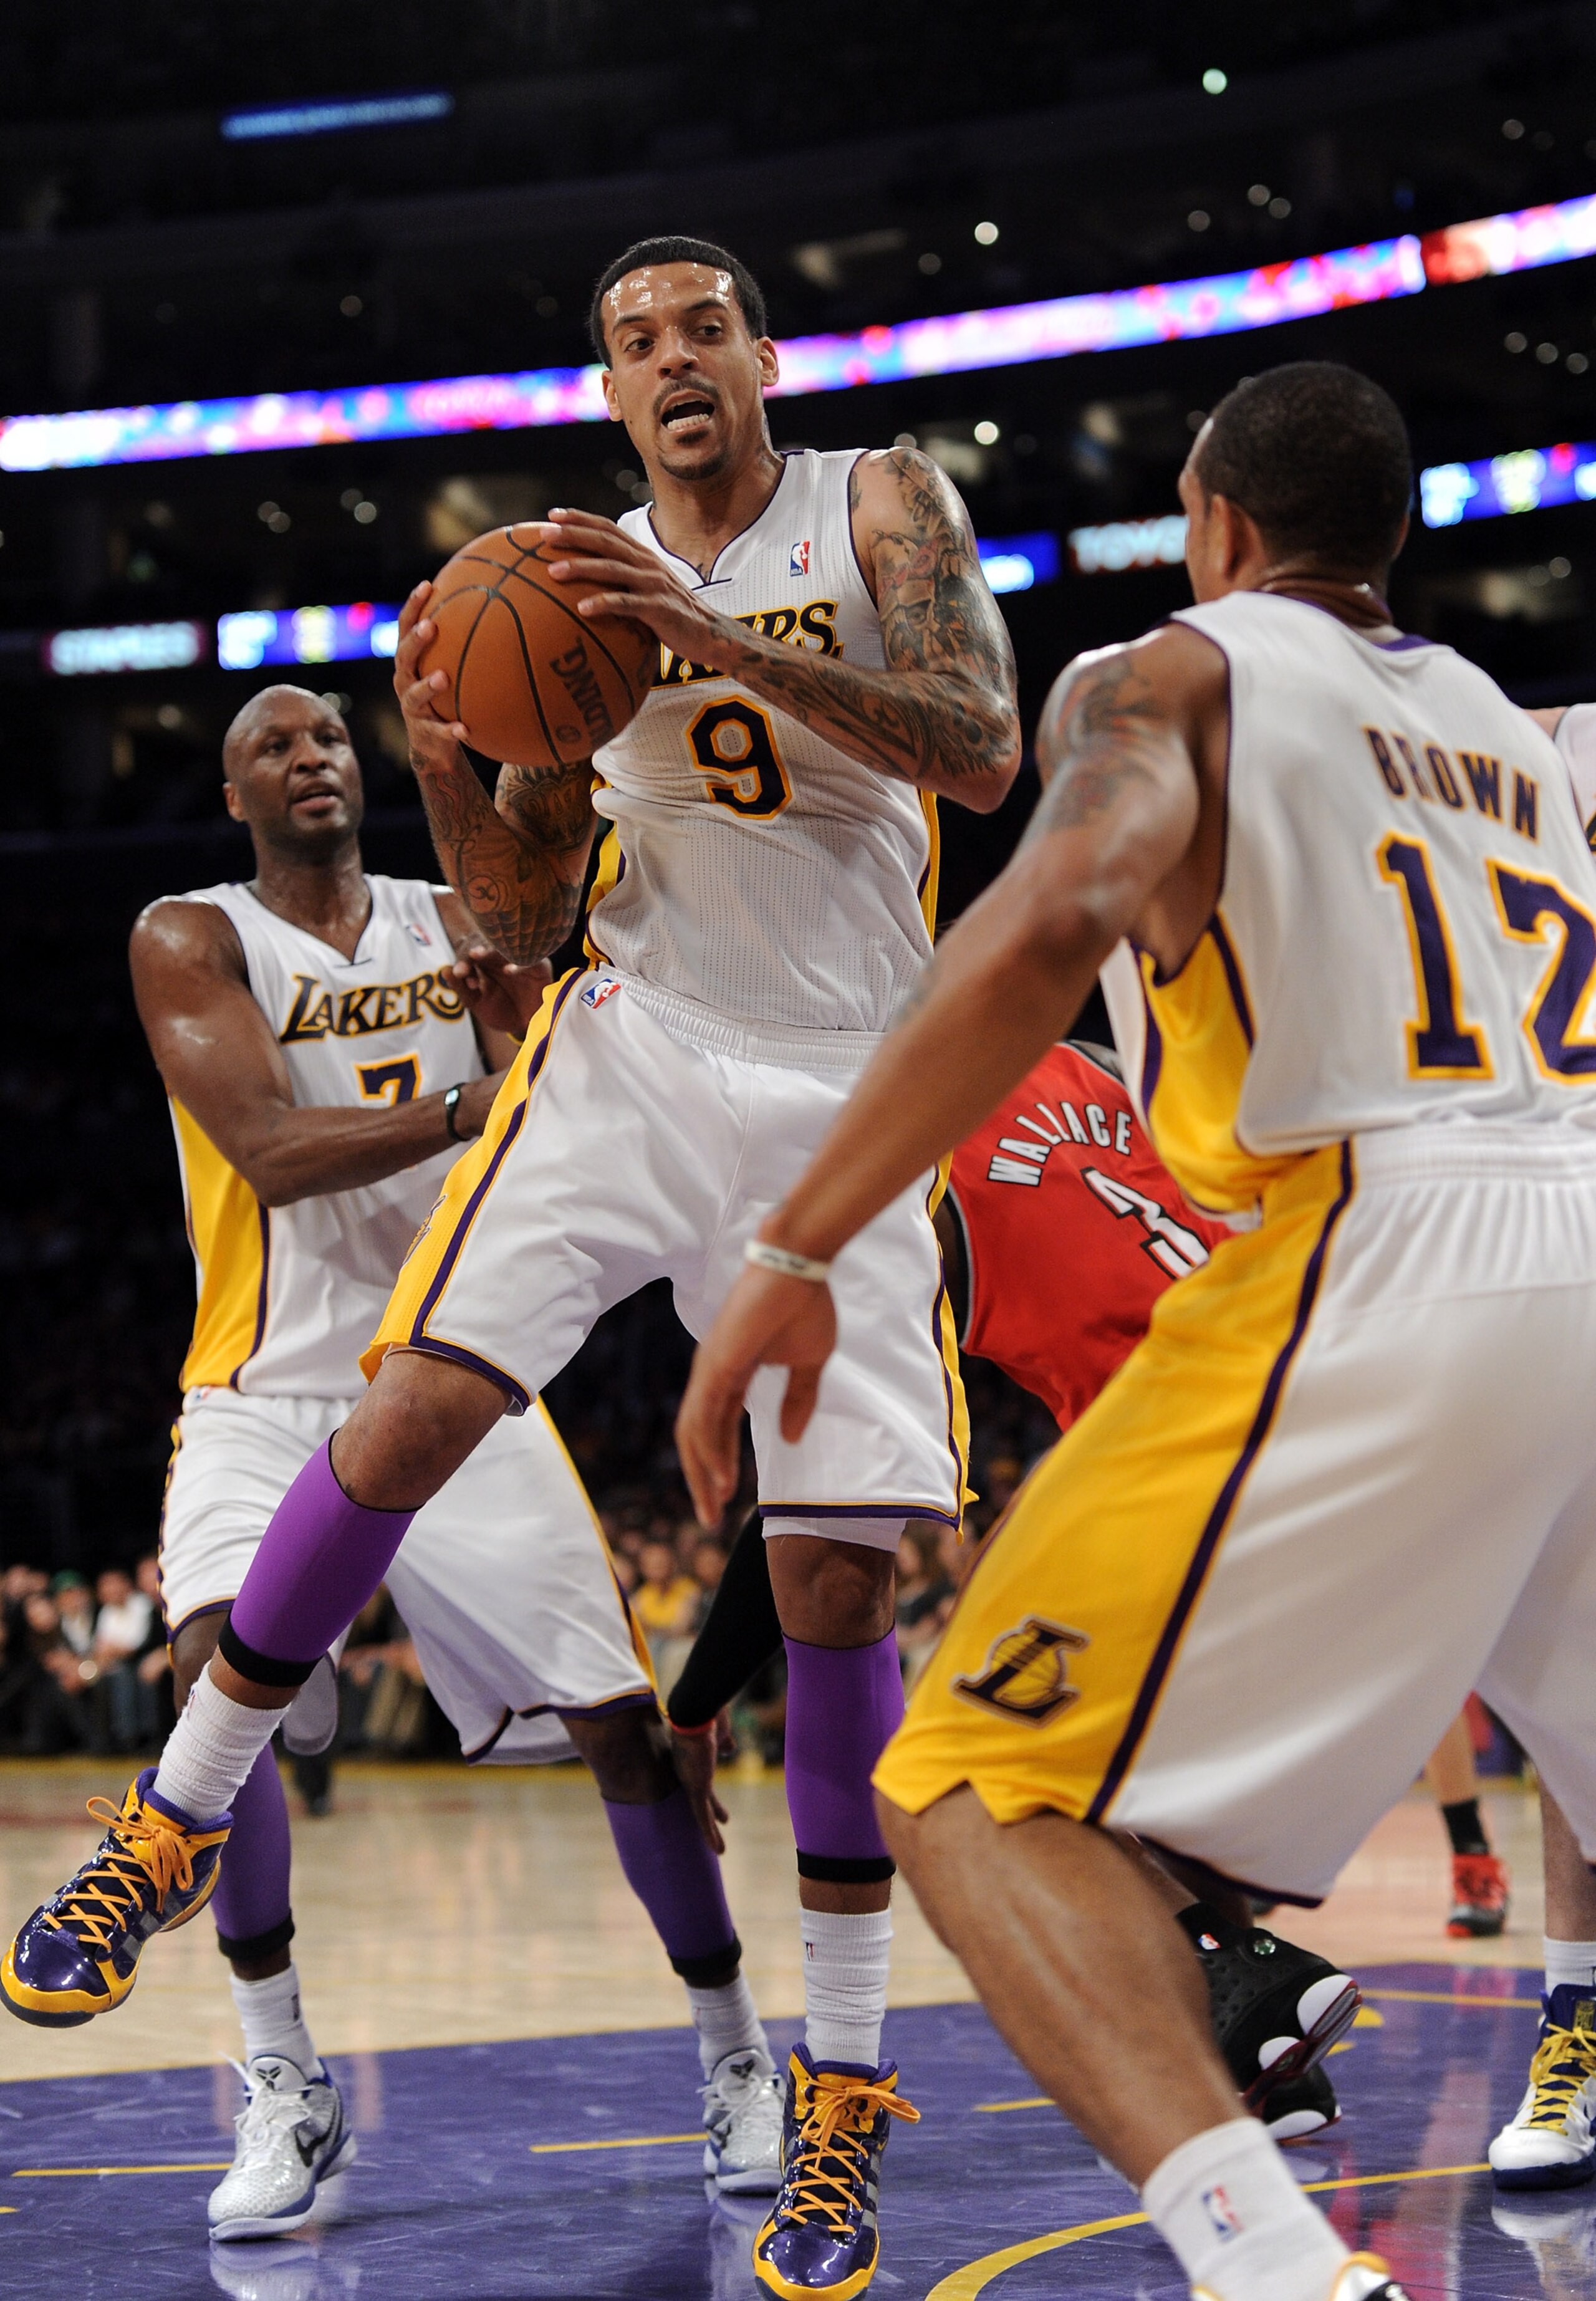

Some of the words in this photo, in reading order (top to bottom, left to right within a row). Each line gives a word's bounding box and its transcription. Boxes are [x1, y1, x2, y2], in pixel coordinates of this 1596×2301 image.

[686, 694, 793, 820] 9
[1363, 726, 1540, 846] BROWN
[278, 964, 466, 1047] LAKERS
[1375, 829, 1596, 1085] 12
[353, 1052, 424, 1106] 7
[987, 1101, 1132, 1187] WALLACE
[1080, 1166, 1210, 1282] 3
